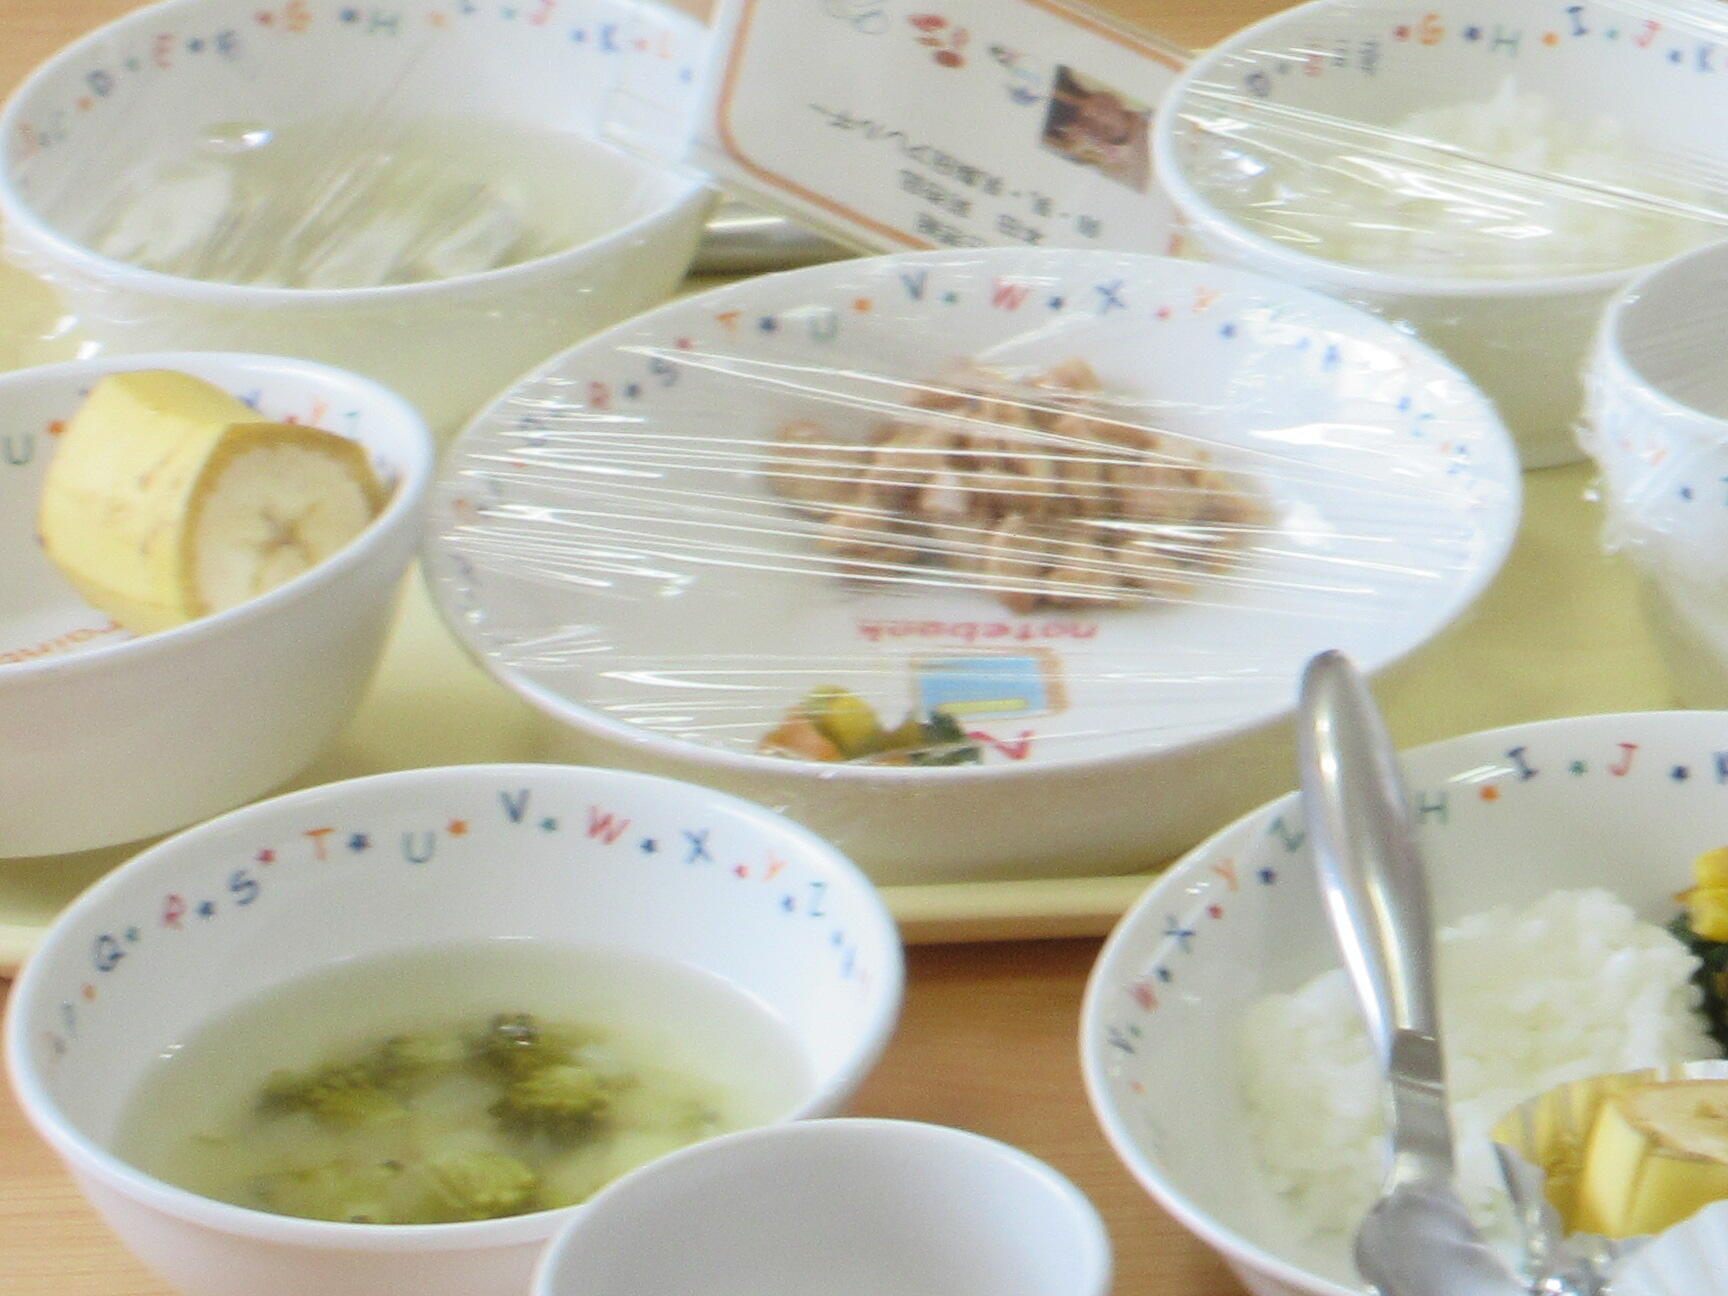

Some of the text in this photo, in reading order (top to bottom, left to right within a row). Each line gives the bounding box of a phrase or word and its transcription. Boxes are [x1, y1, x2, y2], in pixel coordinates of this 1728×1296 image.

[1506, 745, 1540, 781] I
[1607, 742, 1640, 777] J
[228, 870, 260, 905] S
[302, 827, 336, 862] T
[401, 830, 437, 863] U
[498, 788, 530, 822] V
[585, 805, 631, 845] W
[681, 828, 713, 864] X
